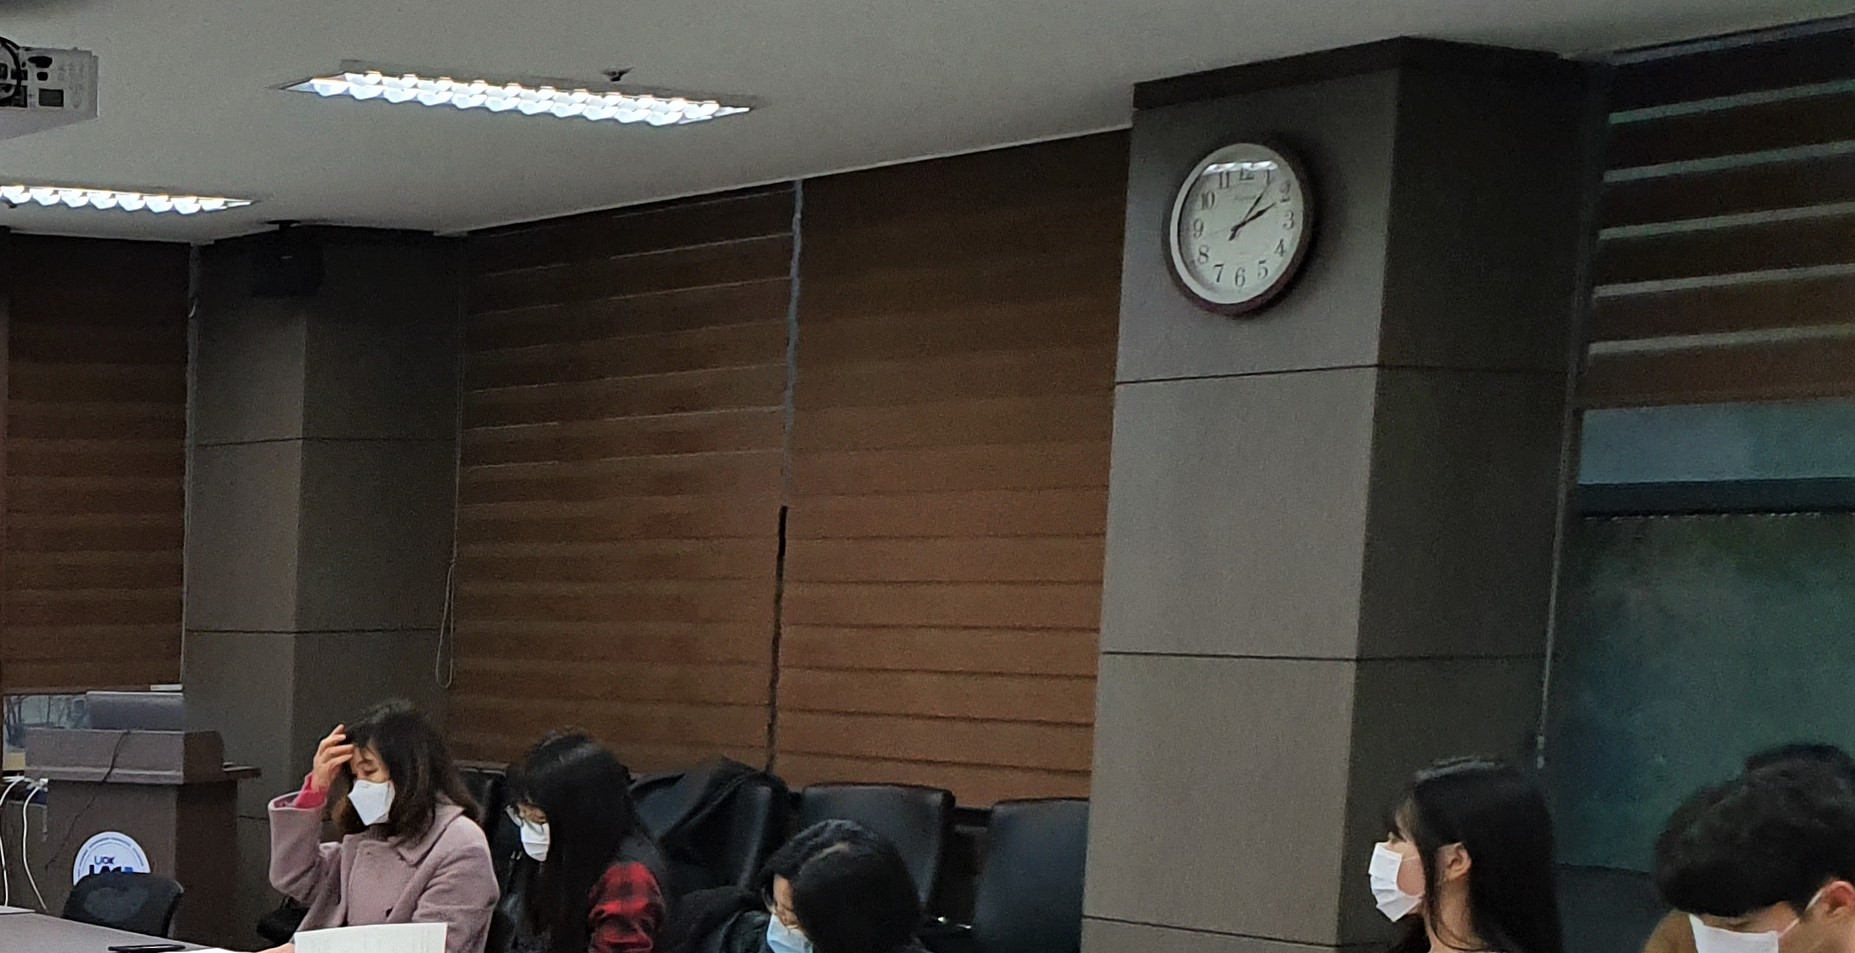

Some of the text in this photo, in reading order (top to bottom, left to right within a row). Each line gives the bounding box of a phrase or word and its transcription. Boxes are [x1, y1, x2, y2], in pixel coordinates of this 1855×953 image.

[1219, 171, 1230, 189] 11
[1201, 191, 1215, 210] 10
[1193, 218, 1204, 238] 9
[1283, 211, 1294, 230] 3
[1197, 245, 1210, 264] 8
[1274, 238, 1285, 257] 4
[1213, 263, 1224, 283] 7
[1235, 266, 1246, 287] 6
[1257, 260, 1268, 279] 5
